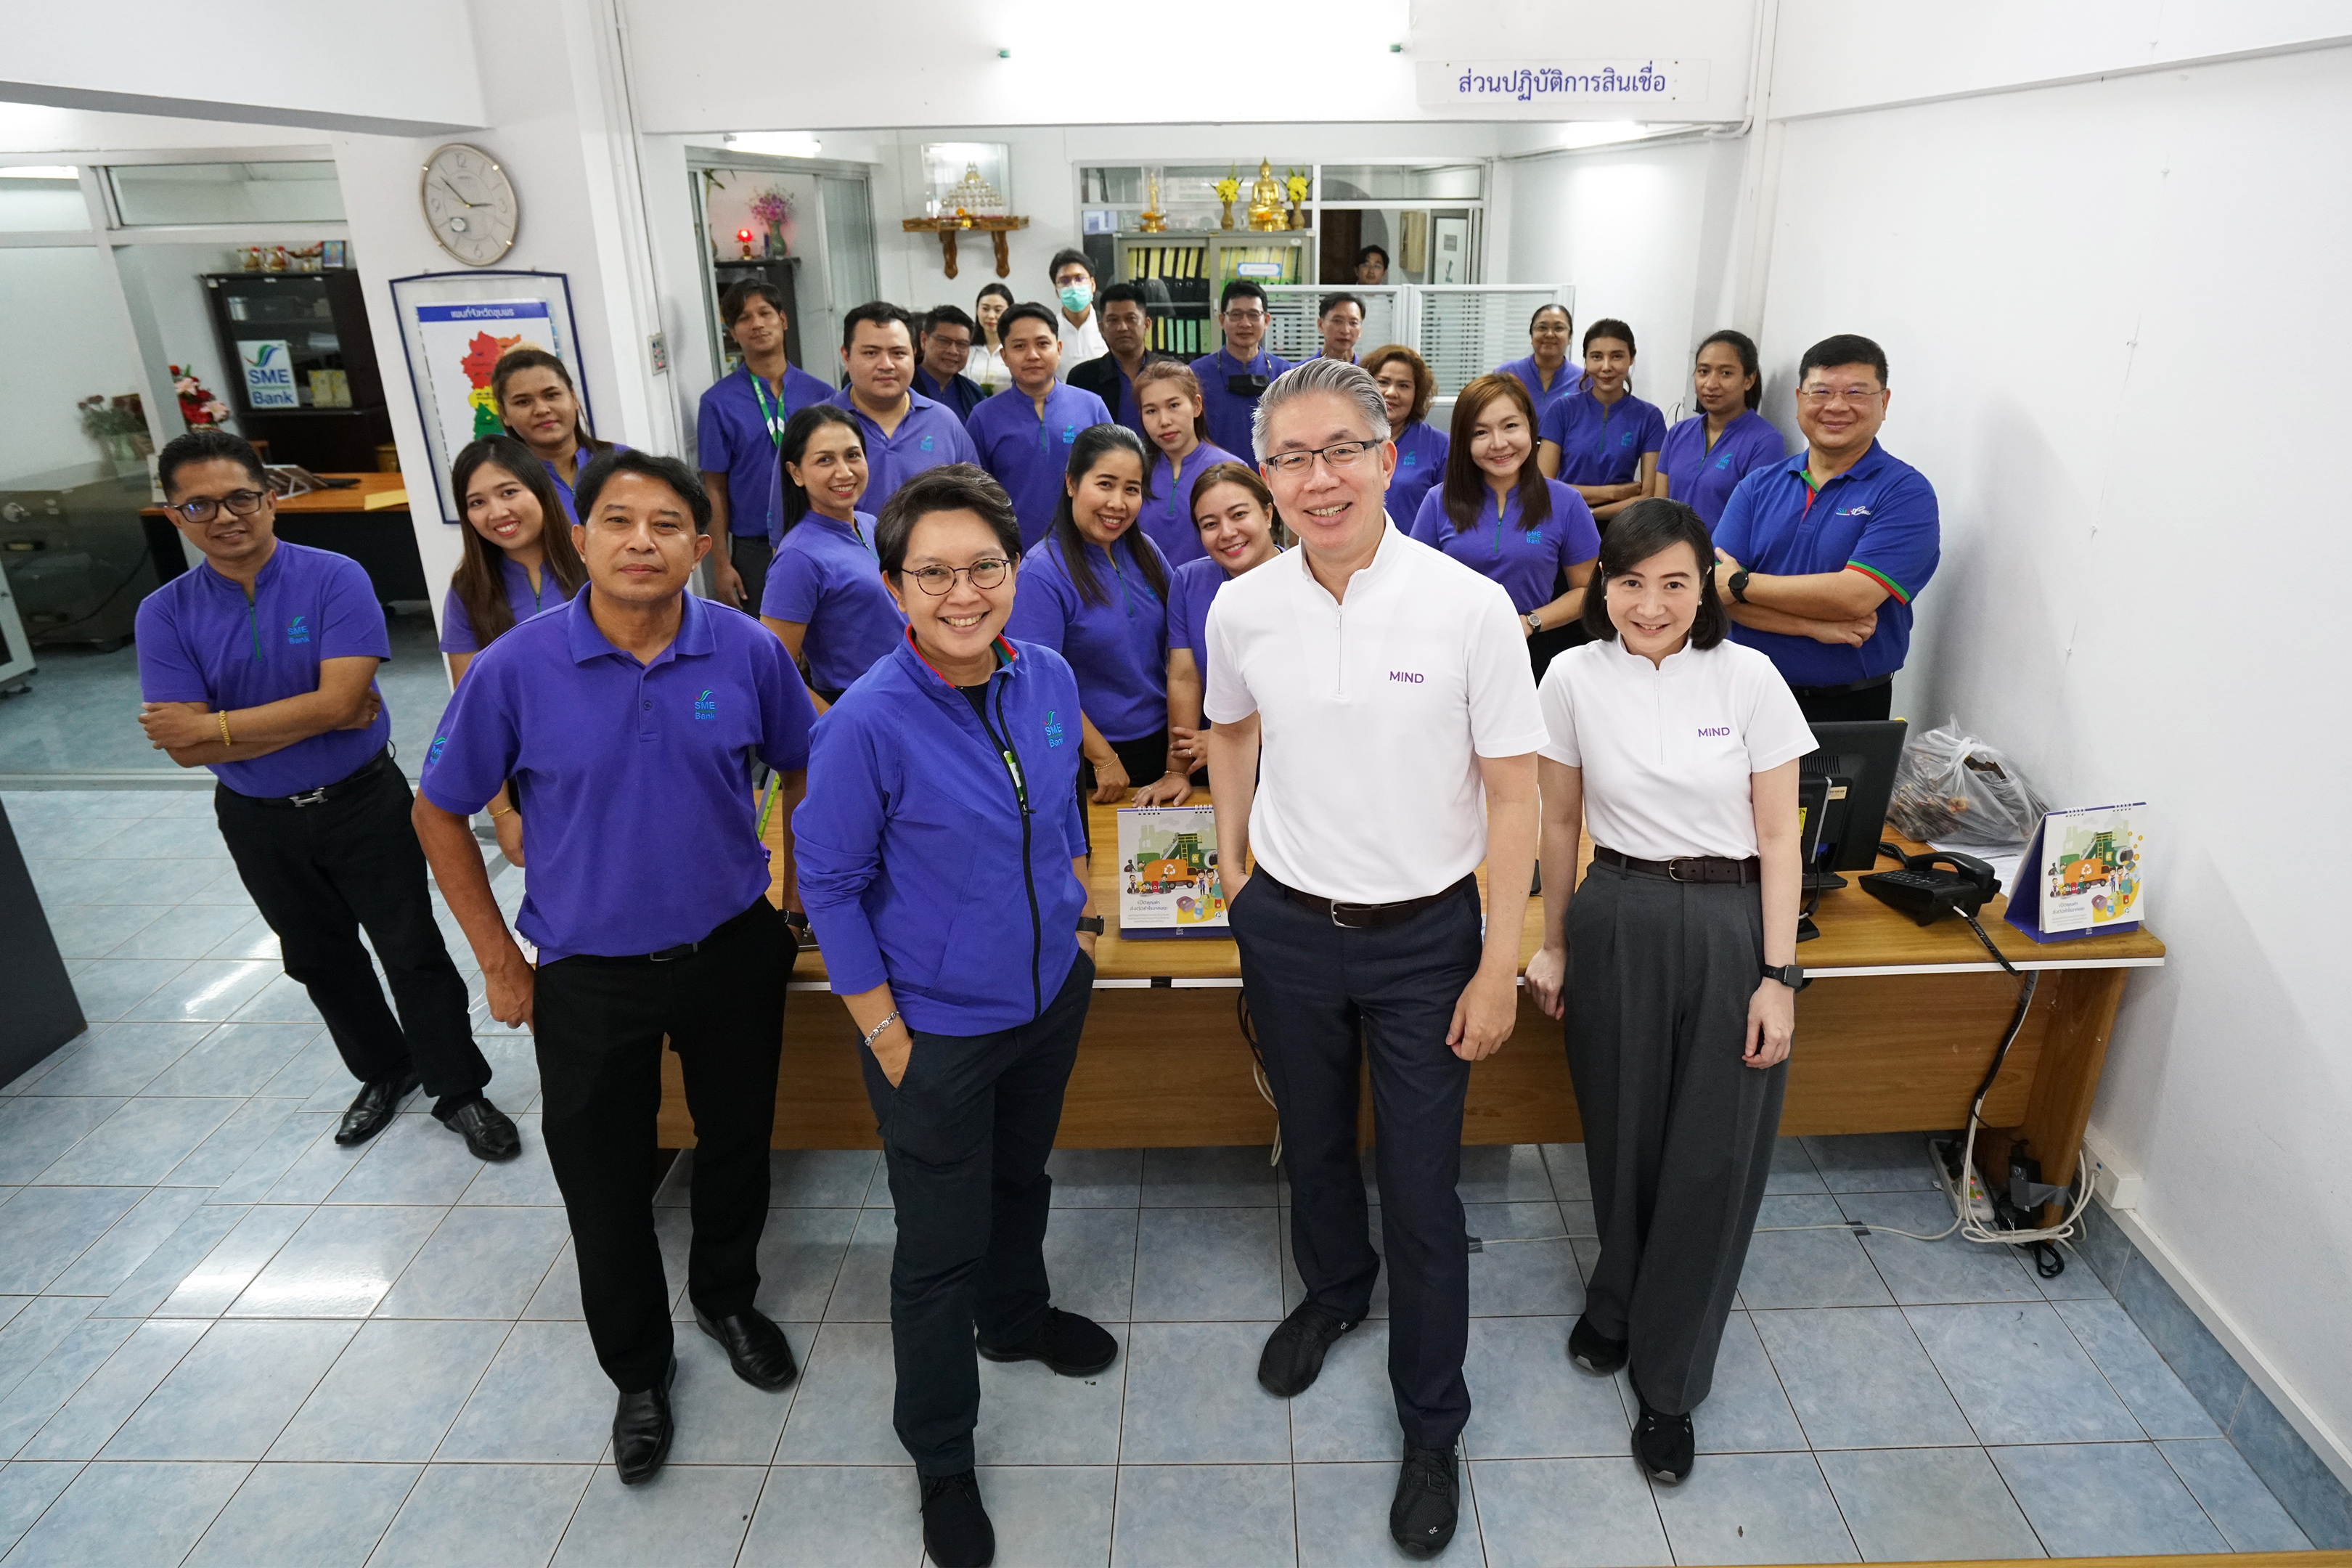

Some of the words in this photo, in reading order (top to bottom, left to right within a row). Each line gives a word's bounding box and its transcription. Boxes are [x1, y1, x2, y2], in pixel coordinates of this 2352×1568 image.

[1458, 60, 1666, 101] ส่วนปฏิบัติการสินเชื่อ
[454, 152, 467, 168] 12
[249, 369, 290, 384] SME
[253, 391, 293, 404] Bank
[287, 626, 309, 635] SME
[1389, 671, 1424, 684] MIND
[1045, 723, 1062, 735] SME
[1698, 727, 1731, 738] MIND
[1049, 736, 1063, 748] Bank
